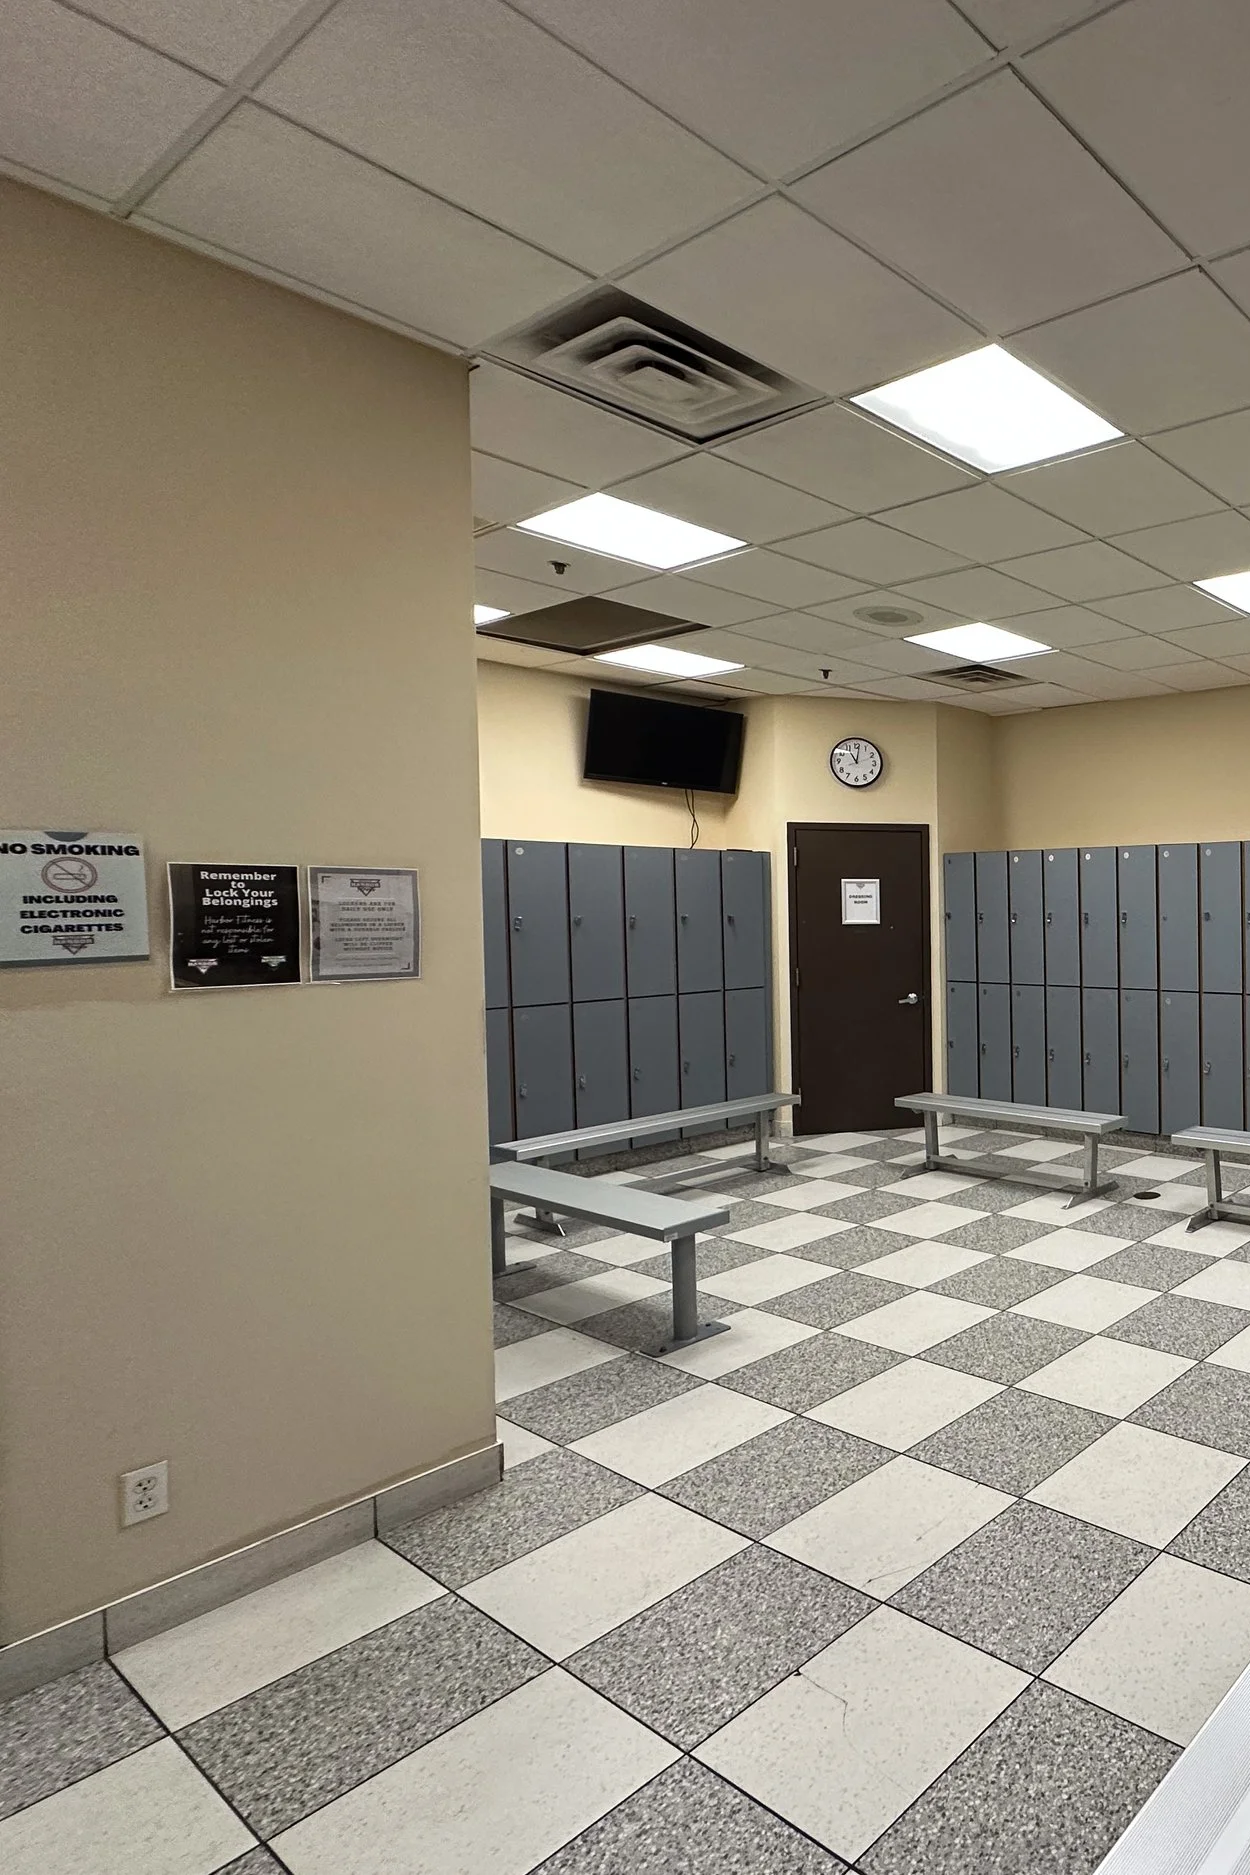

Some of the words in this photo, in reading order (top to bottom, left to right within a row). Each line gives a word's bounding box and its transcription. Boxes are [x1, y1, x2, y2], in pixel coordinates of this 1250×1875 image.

[869, 751, 875, 759] 2
[836, 757, 842, 765] 9
[871, 759, 877, 767] 3
[839, 766, 845, 774] 8
[869, 768, 874, 776] 4
[845, 772, 851, 780] 7
[854, 775, 860, 783] 6
[862, 773, 868, 781] 5
[0, 843, 28, 855] NO
[31, 844, 140, 857] SMOKING
[200, 871, 277, 881] Remember
[230, 881, 246, 889] to
[205, 888, 239, 898] Lock
[242, 888, 275, 898] Your
[23, 895, 119, 905] INCLUDING
[202, 896, 279, 909] Belongings
[20, 909, 125, 919] ELECTRONIC
[20, 923, 124, 935] CIGARETTES
